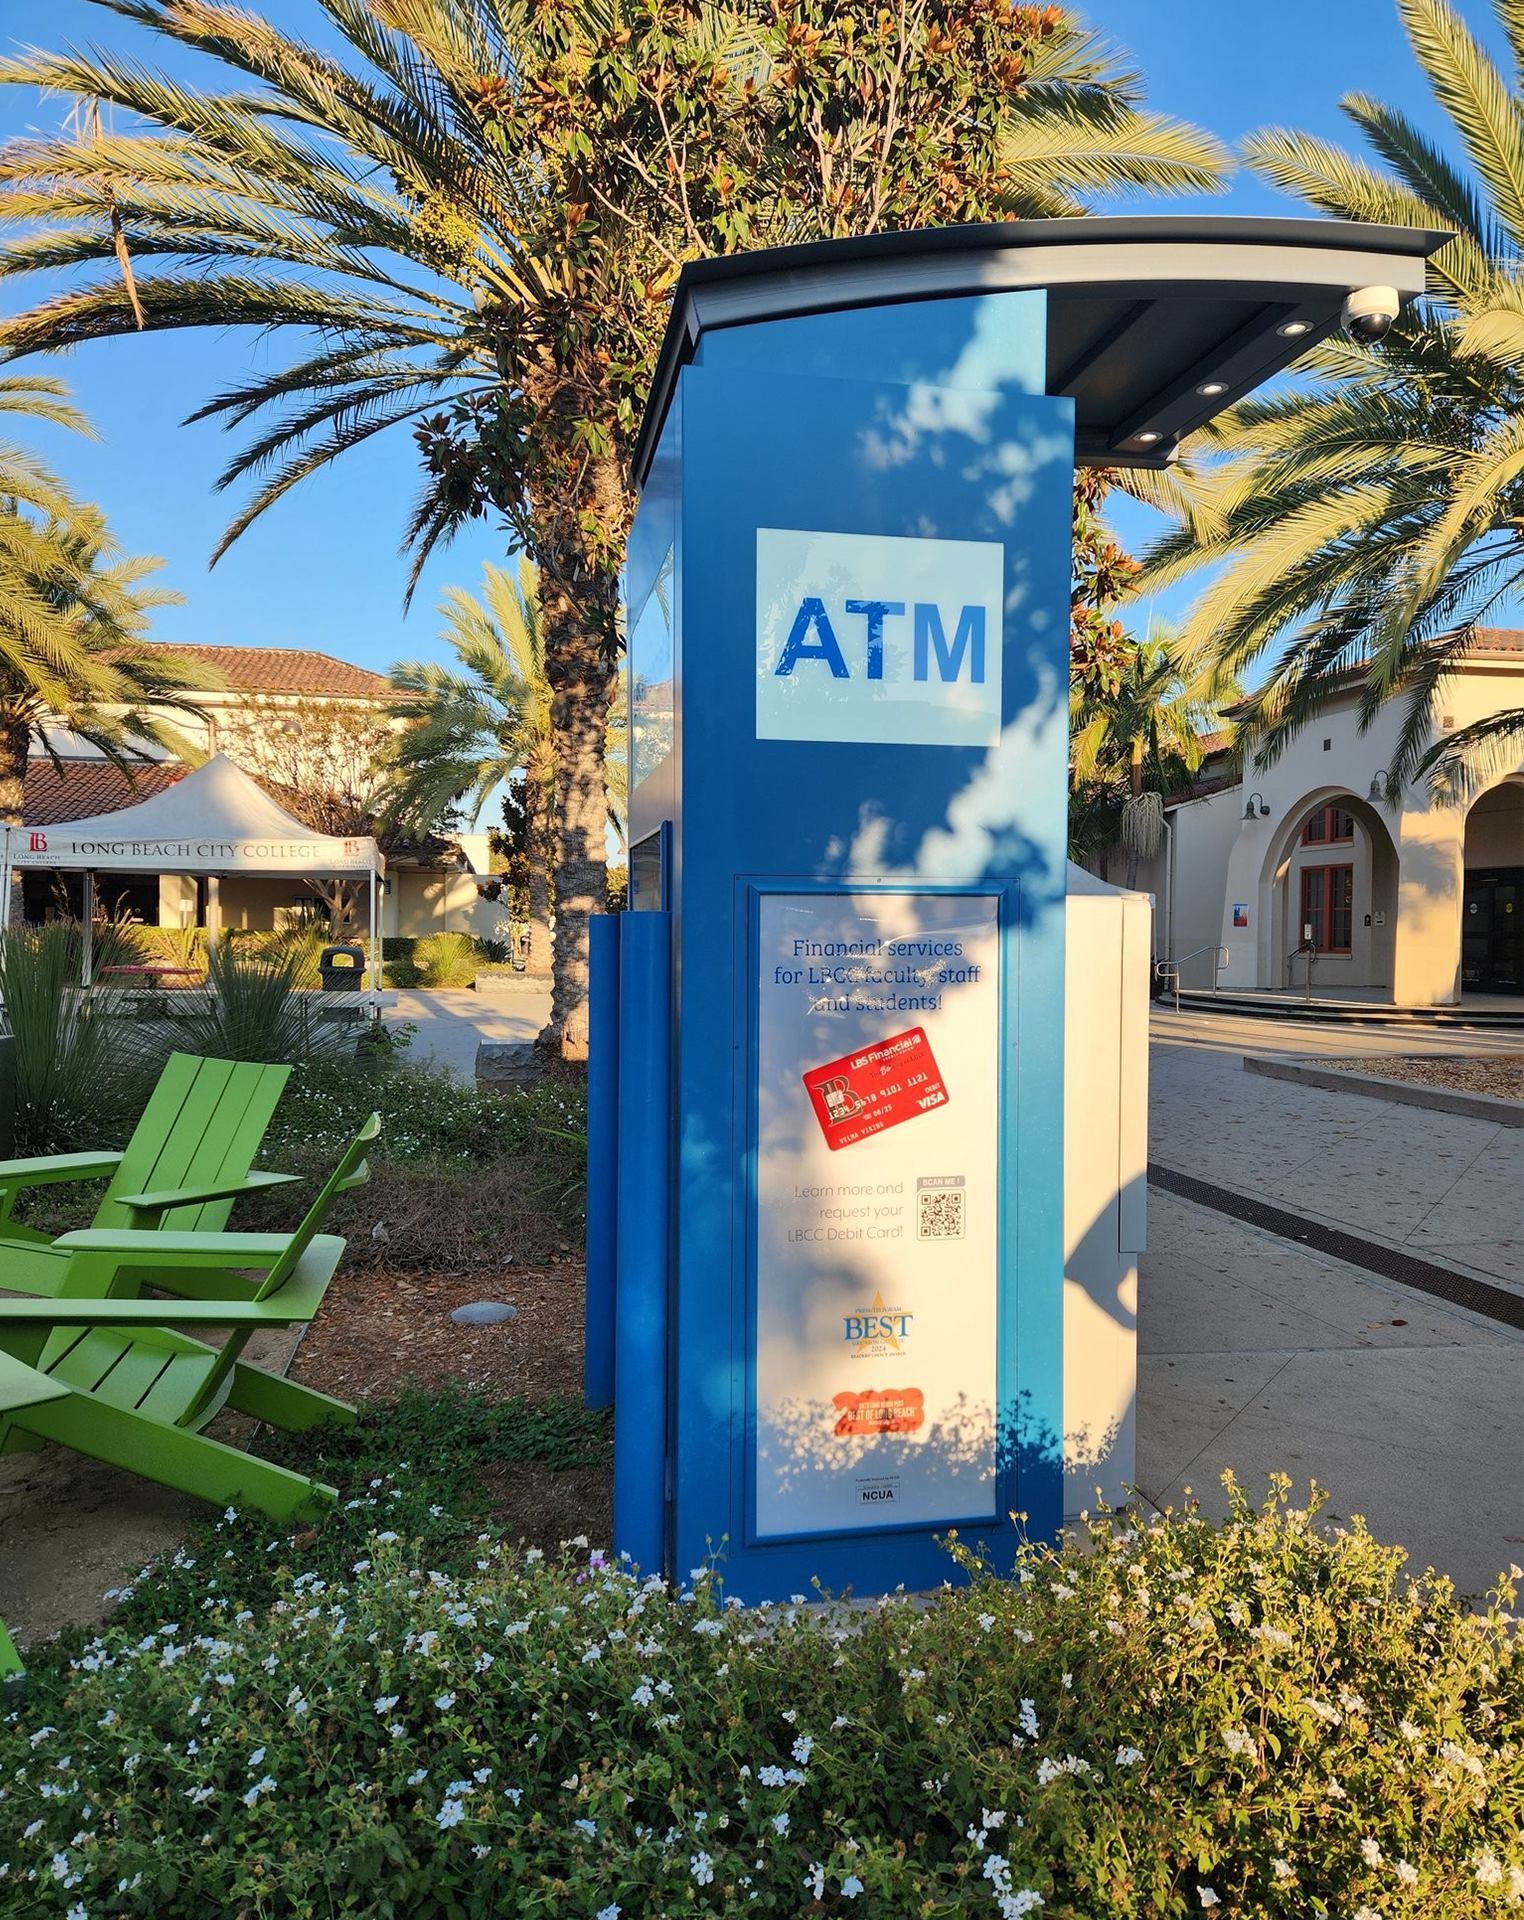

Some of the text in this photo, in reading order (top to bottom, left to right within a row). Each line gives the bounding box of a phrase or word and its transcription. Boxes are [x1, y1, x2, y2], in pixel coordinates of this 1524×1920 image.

[774, 597, 986, 684] ATM
[36, 853, 60, 861] BEACH
[72, 842, 321, 858] LONG BEACH CITY COLLEGE
[793, 939, 963, 957] Financial services
[774, 966, 803, 984] for
[865, 966, 934, 988] faculty
[939, 965, 982, 984] staff
[815, 993, 943, 1012] and students!
[850, 1056, 869, 1070] LBS
[868, 1037, 913, 1063] Financial
[829, 1104, 850, 1121] 1234
[854, 1093, 878, 1110] 5678
[880, 1083, 903, 1098] 9101
[907, 1072, 929, 1088] 1121
[915, 1091, 946, 1110] VISA
[873, 1104, 893, 1117] 06/25
[860, 1121, 885, 1135] VIKING
[794, 1182, 904, 1198] Learn more and
[922, 1178, 944, 1187] SCAN
[820, 1205, 904, 1222] request your
[788, 1225, 904, 1243] LBCC Debit Card!
[842, 1314, 914, 1341] BEST
[871, 1345, 887, 1353] 2024
[848, 1409, 865, 1422] BEST
[865, 1409, 874, 1421] OF
[893, 1405, 915, 1418] BEACH
[862, 1489, 894, 1502] NCUA
